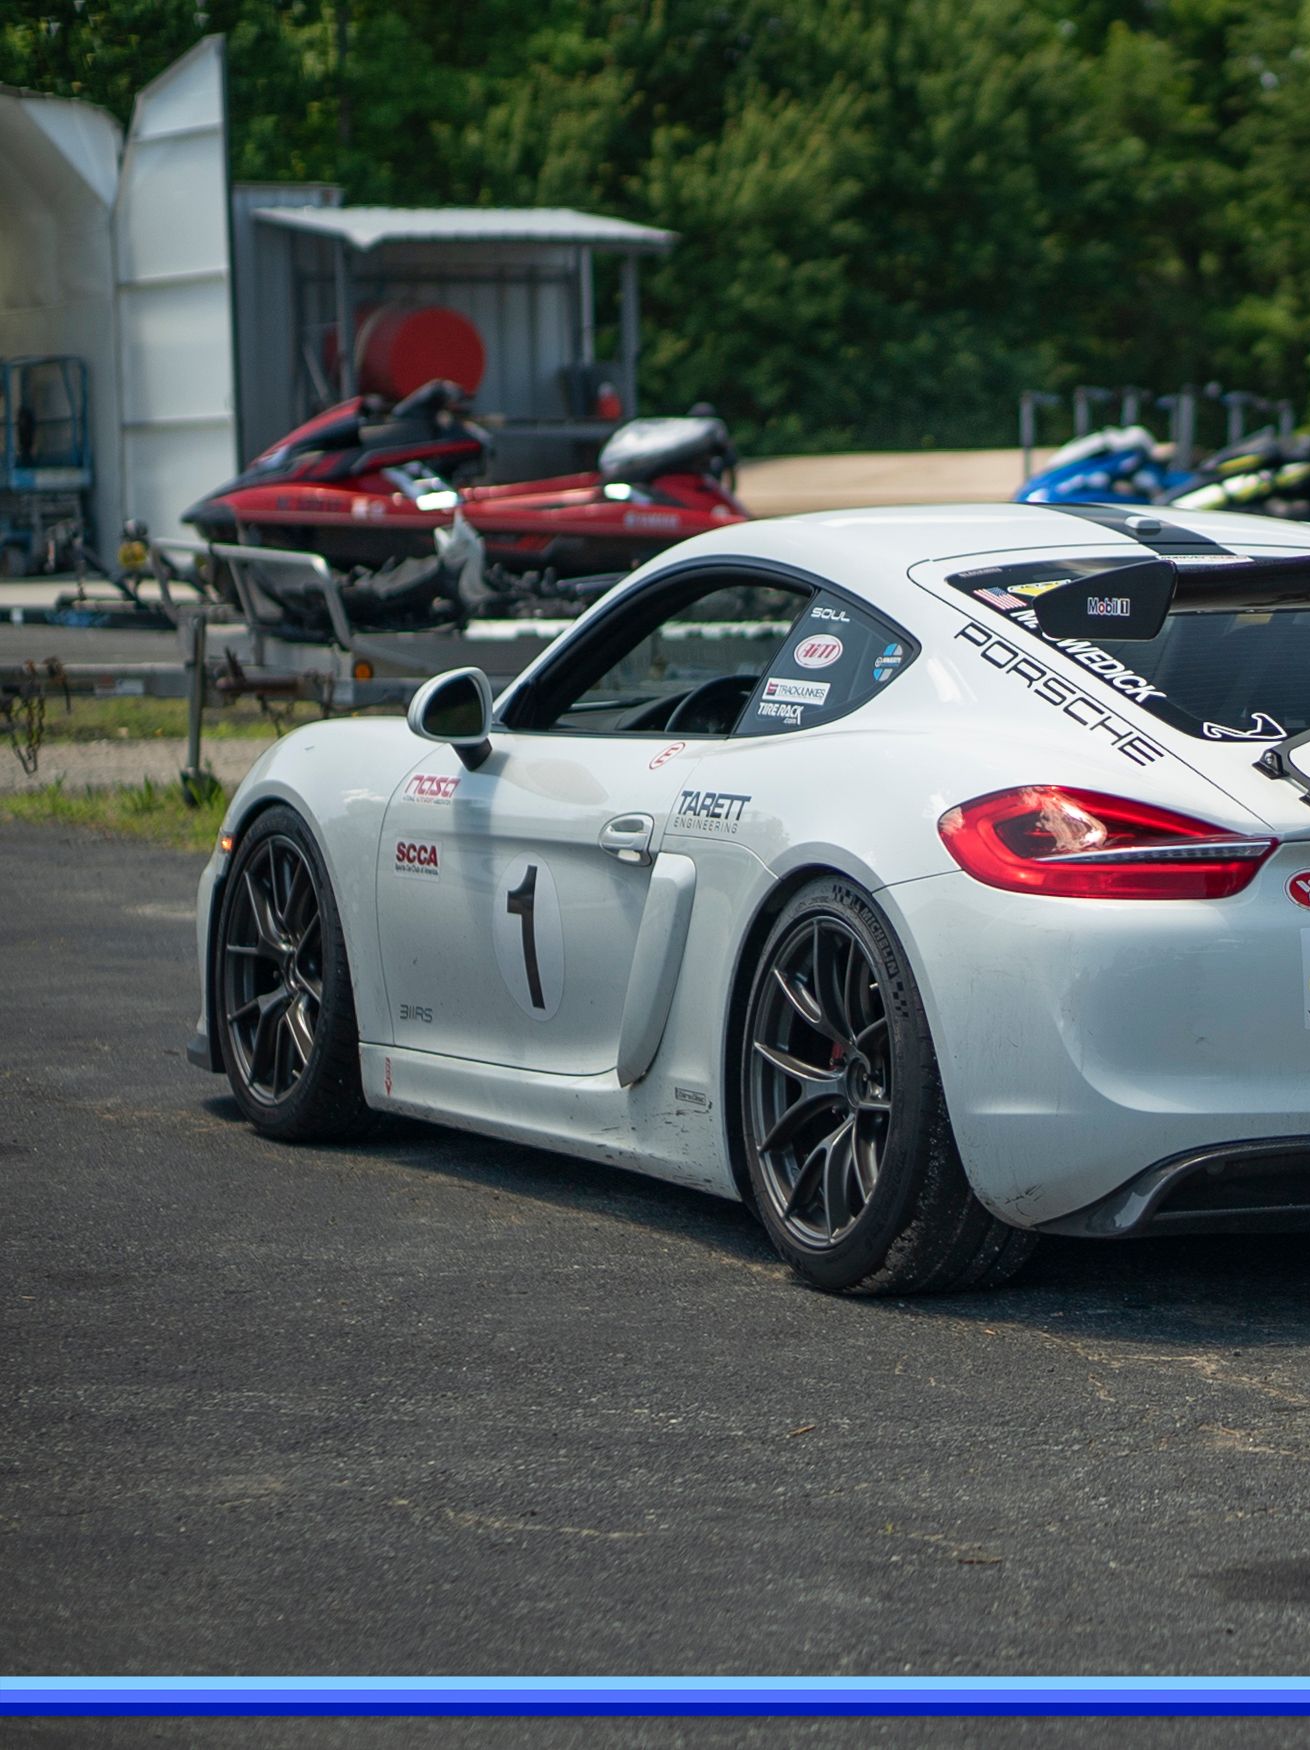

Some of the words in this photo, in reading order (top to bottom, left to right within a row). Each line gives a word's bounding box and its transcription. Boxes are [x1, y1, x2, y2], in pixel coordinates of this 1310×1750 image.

[811, 607, 850, 622] SOUL
[1042, 632, 1167, 703] WEDICK
[954, 622, 1164, 767] PORSCHE
[674, 816, 738, 834] ENGINEERING
[678, 790, 752, 821] TARETT
[396, 841, 438, 867] SCCA
[507, 865, 546, 1010] 1
[860, 907, 899, 976] MICHELIN
